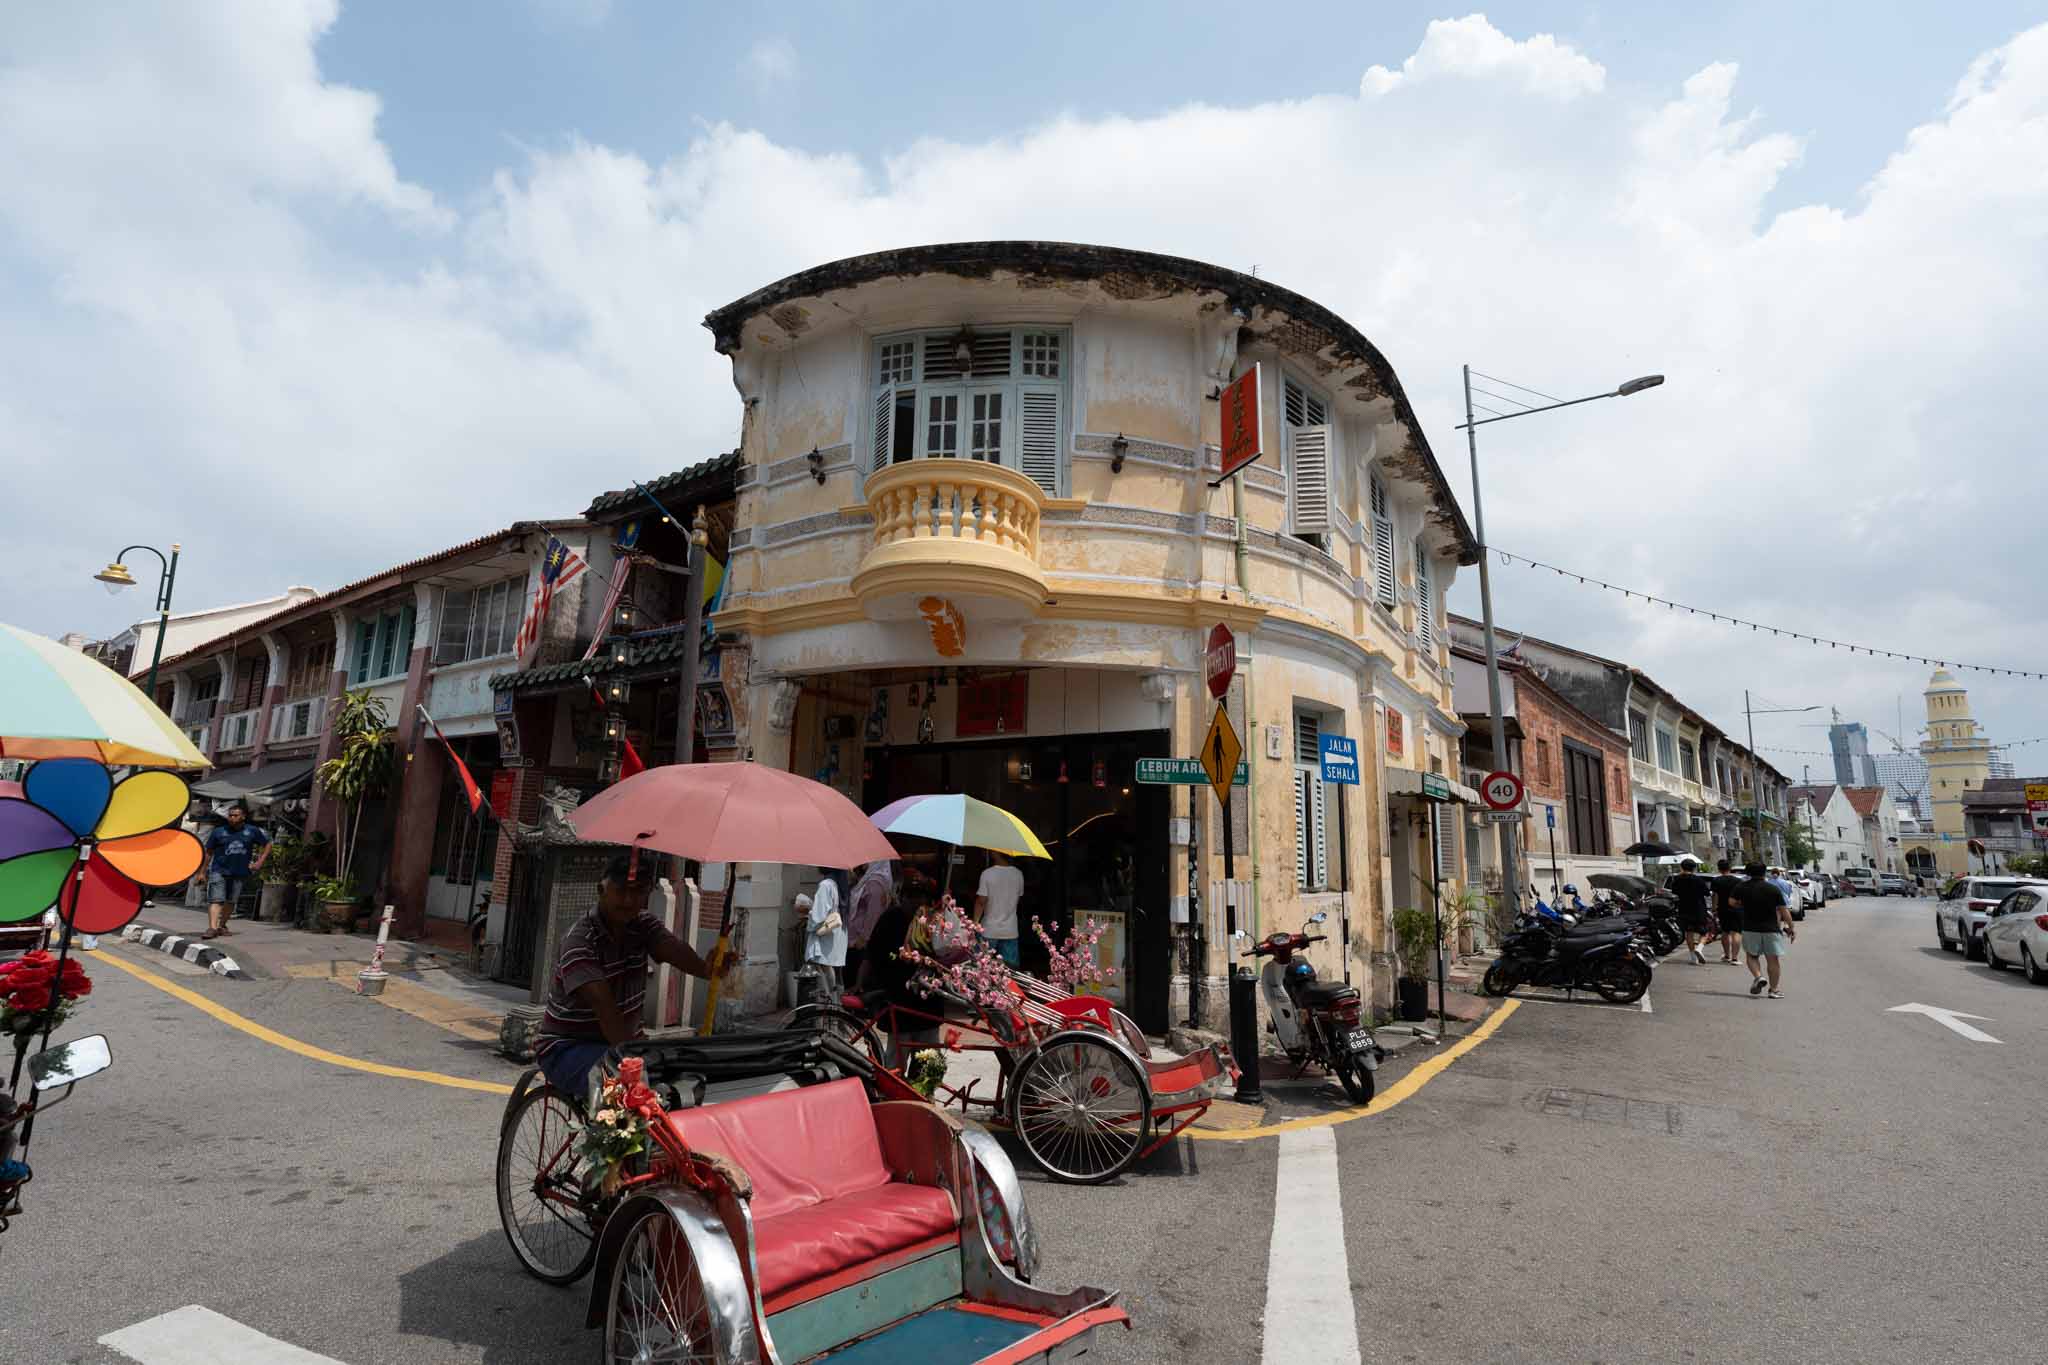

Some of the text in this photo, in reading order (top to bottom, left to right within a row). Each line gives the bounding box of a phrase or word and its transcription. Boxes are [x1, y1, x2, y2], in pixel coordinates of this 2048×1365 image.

[1328, 739, 1352, 753] JALAN
[1141, 761, 1179, 773] LEBUH
[1327, 765, 1355, 780] SEHALA
[1491, 784, 1513, 797] 40
